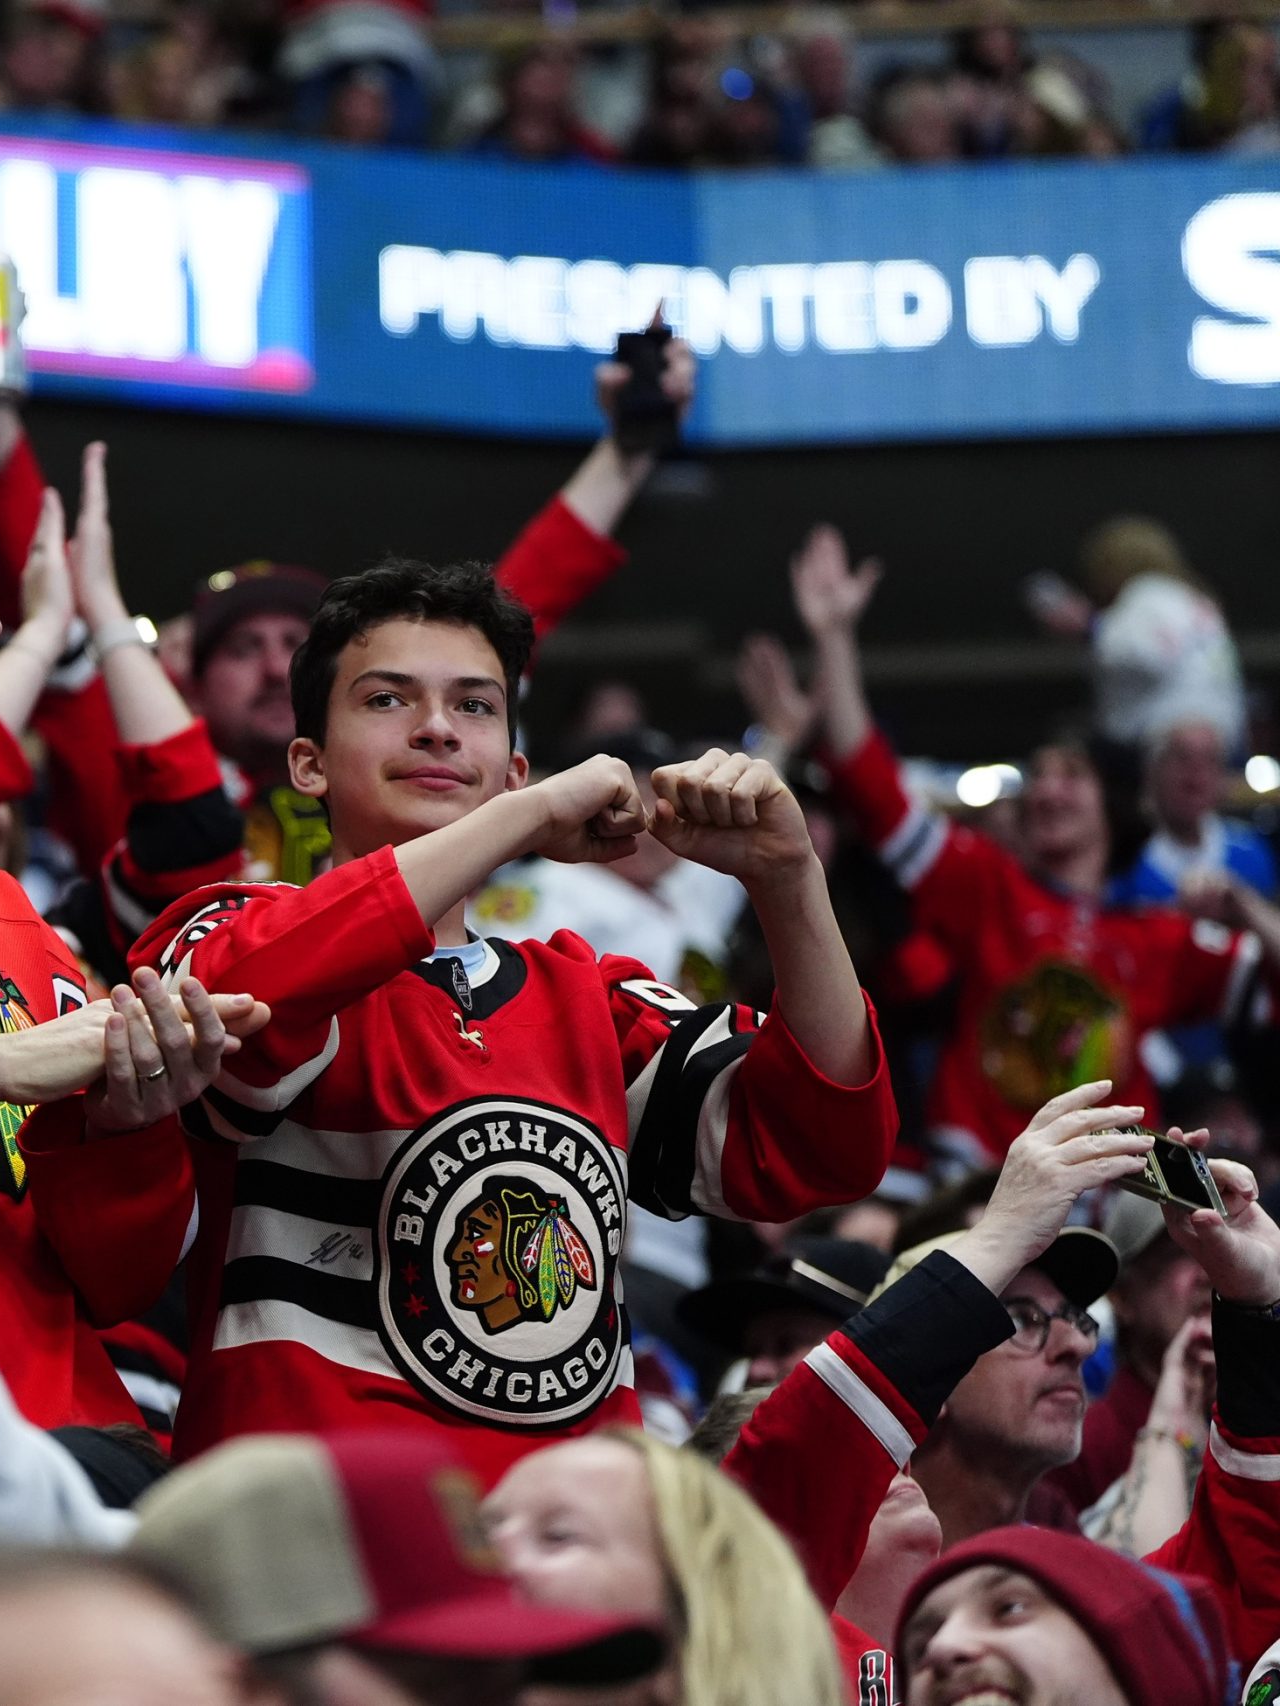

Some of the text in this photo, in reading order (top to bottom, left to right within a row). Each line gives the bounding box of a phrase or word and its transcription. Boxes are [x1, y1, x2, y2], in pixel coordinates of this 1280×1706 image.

[378, 243, 1101, 356] PRESENTED BY
[394, 1120, 621, 1257] BLACKHAWKS
[422, 1328, 607, 1403] CHICAGO
